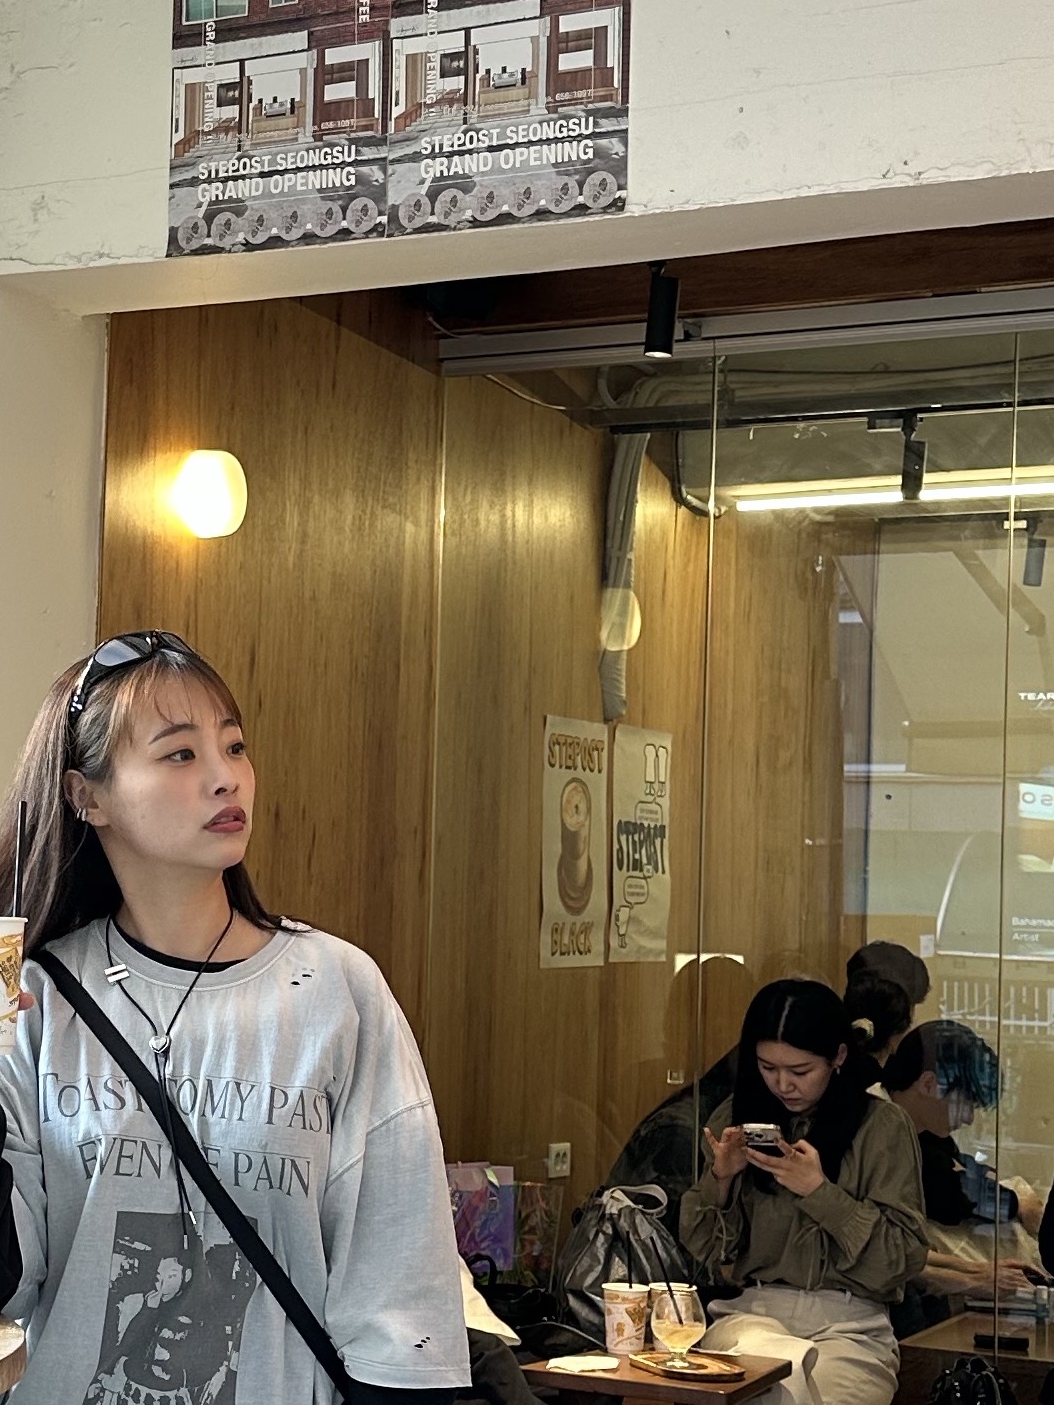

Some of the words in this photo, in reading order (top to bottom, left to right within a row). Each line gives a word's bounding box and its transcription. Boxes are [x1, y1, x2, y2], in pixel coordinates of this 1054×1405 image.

[426, 0, 439, 38] RAND
[205, 21, 217, 68] GRAND
[420, 128, 501, 155] STEPOST
[505, 116, 594, 145] SEONGSU
[198, 155, 272, 180] STEPOST
[276, 144, 356, 171] SEONGSU
[420, 152, 493, 179] GRAND
[499, 139, 594, 170] OPENING
[197, 177, 264, 203] GRAND
[269, 166, 356, 194] OPENING
[548, 732, 605, 774] STEPOST
[616, 819, 667, 875] STEPOST
[550, 920, 594, 957] BLACK
[77, 1136, 164, 1180] EVEN
[233, 1151, 311, 1199] PAIN
